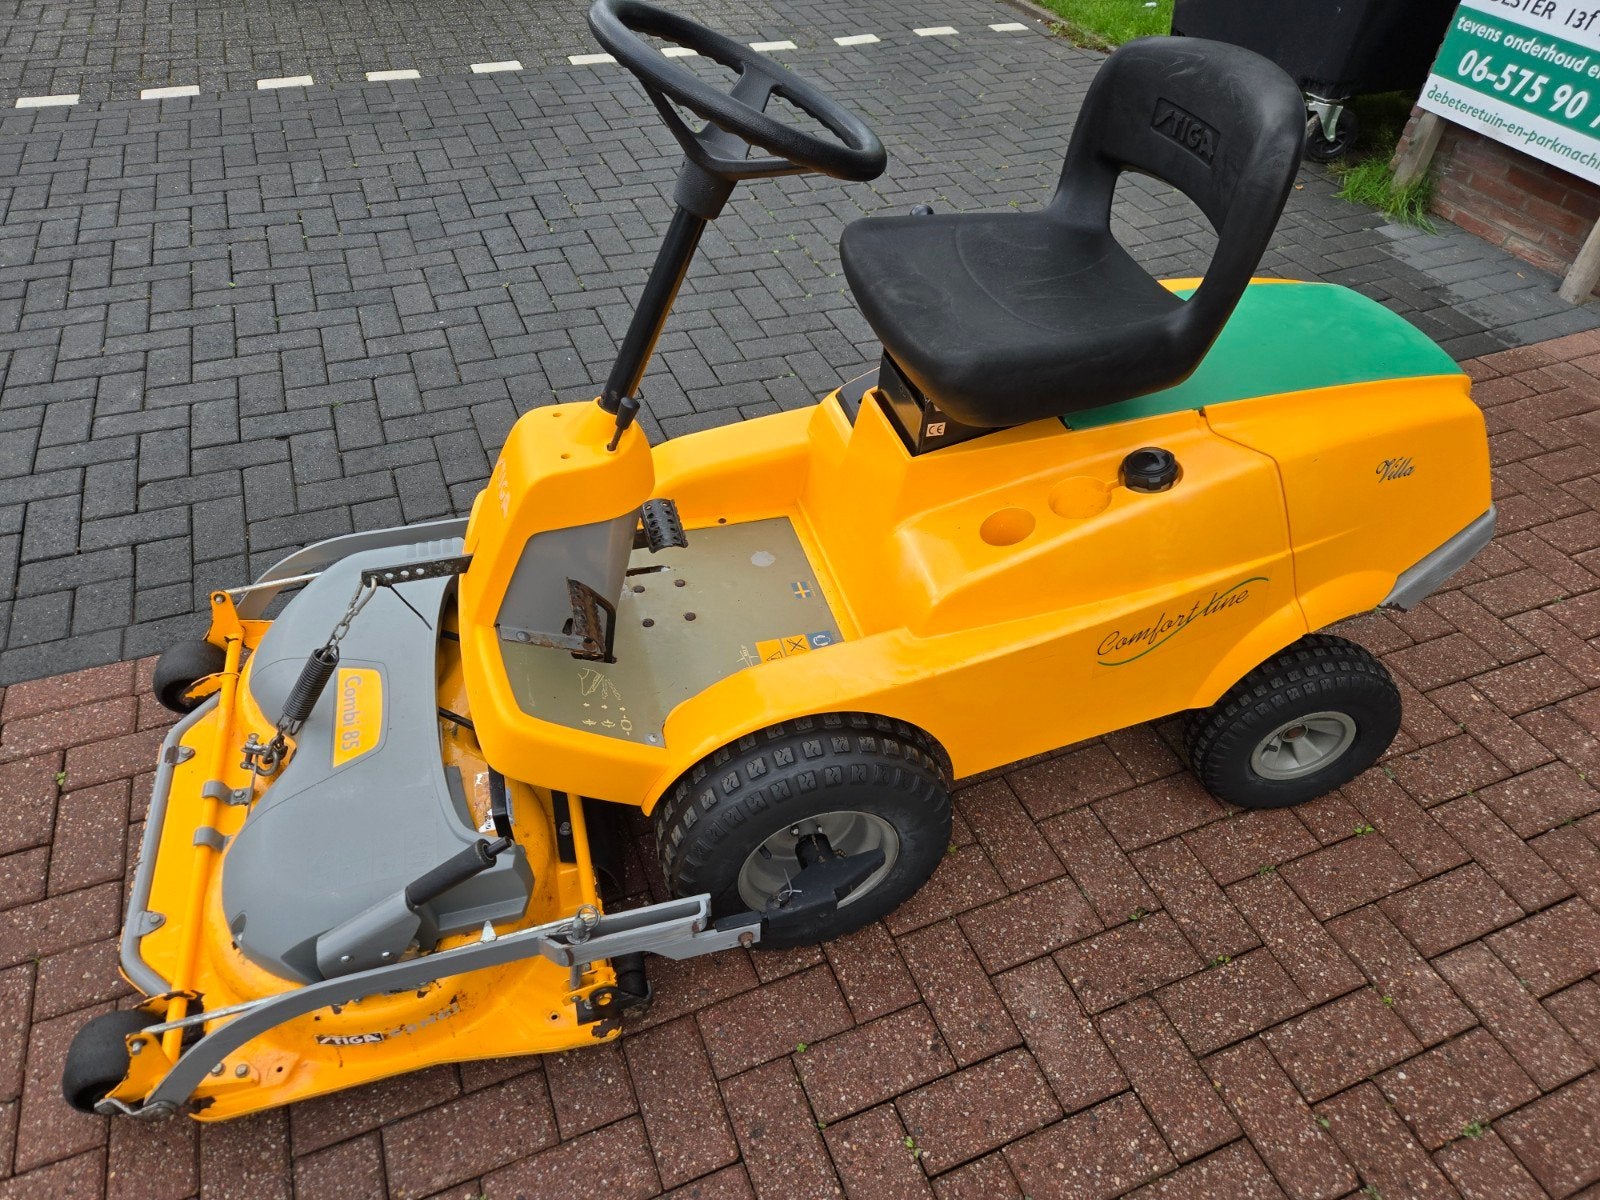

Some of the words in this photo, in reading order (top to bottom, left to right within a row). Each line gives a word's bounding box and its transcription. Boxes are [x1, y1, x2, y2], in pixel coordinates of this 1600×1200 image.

[1457, 16, 1502, 43] tevens
[1503, 37, 1589, 73] onderhoud
[1457, 49, 1549, 104] 06-575
[1548, 84, 1589, 120] 90
[1375, 456, 1415, 484] Villa
[343, 675, 362, 728] Combi
[341, 730, 360, 751] 85
